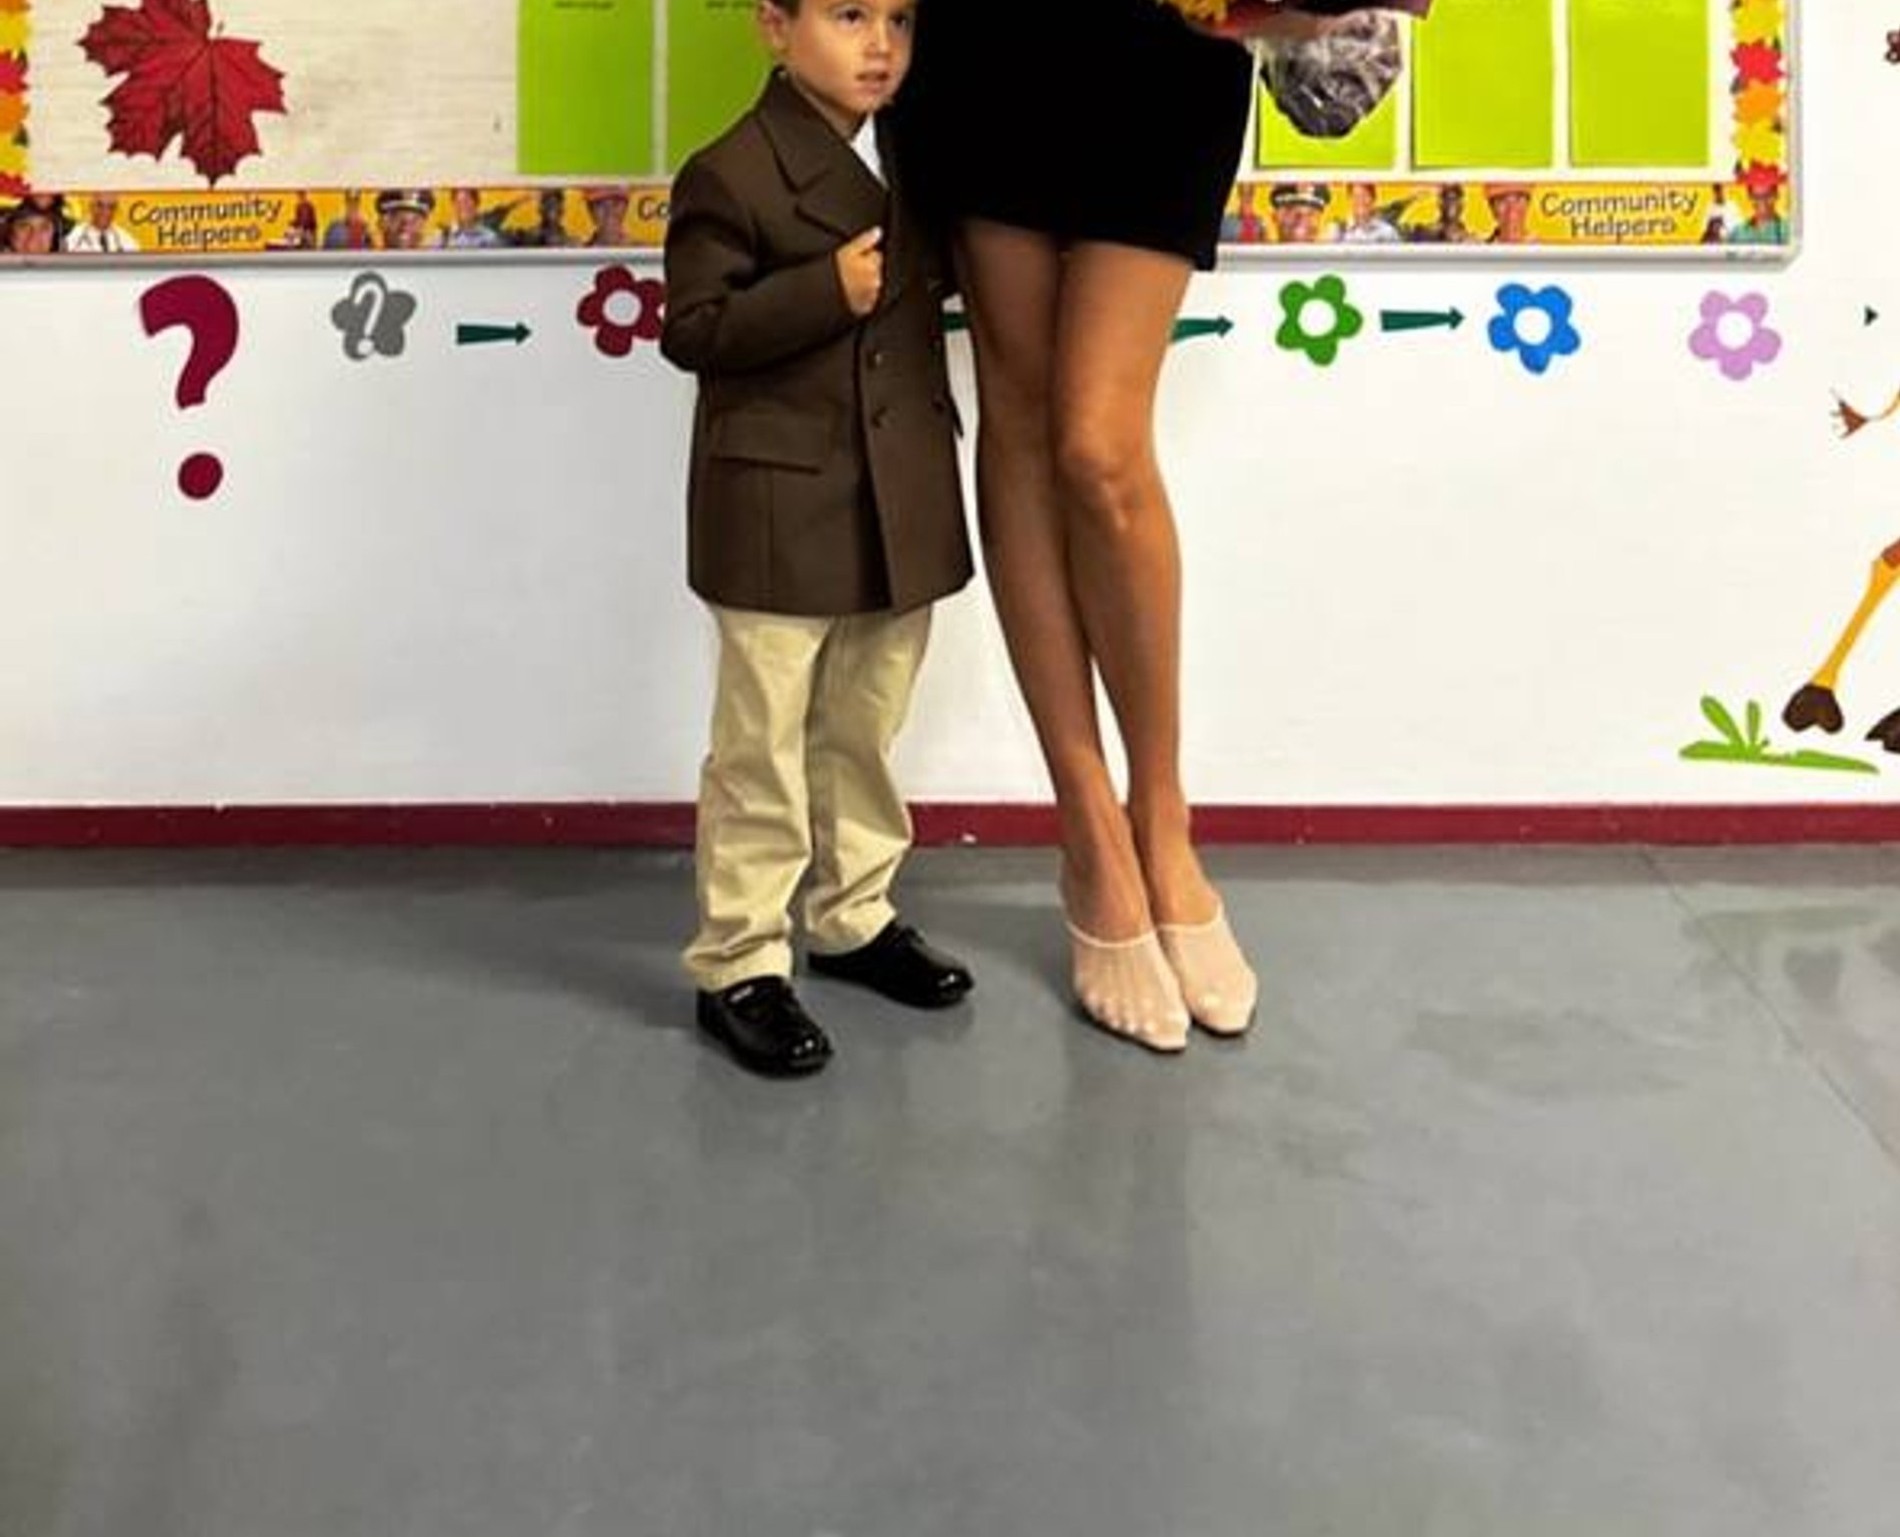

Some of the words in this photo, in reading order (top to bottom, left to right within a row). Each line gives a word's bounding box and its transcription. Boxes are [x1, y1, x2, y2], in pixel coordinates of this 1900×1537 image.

[129, 195, 283, 226] Community
[1541, 189, 1699, 217] Community
[158, 223, 263, 252] Helpers
[1571, 216, 1677, 245] Helpers
